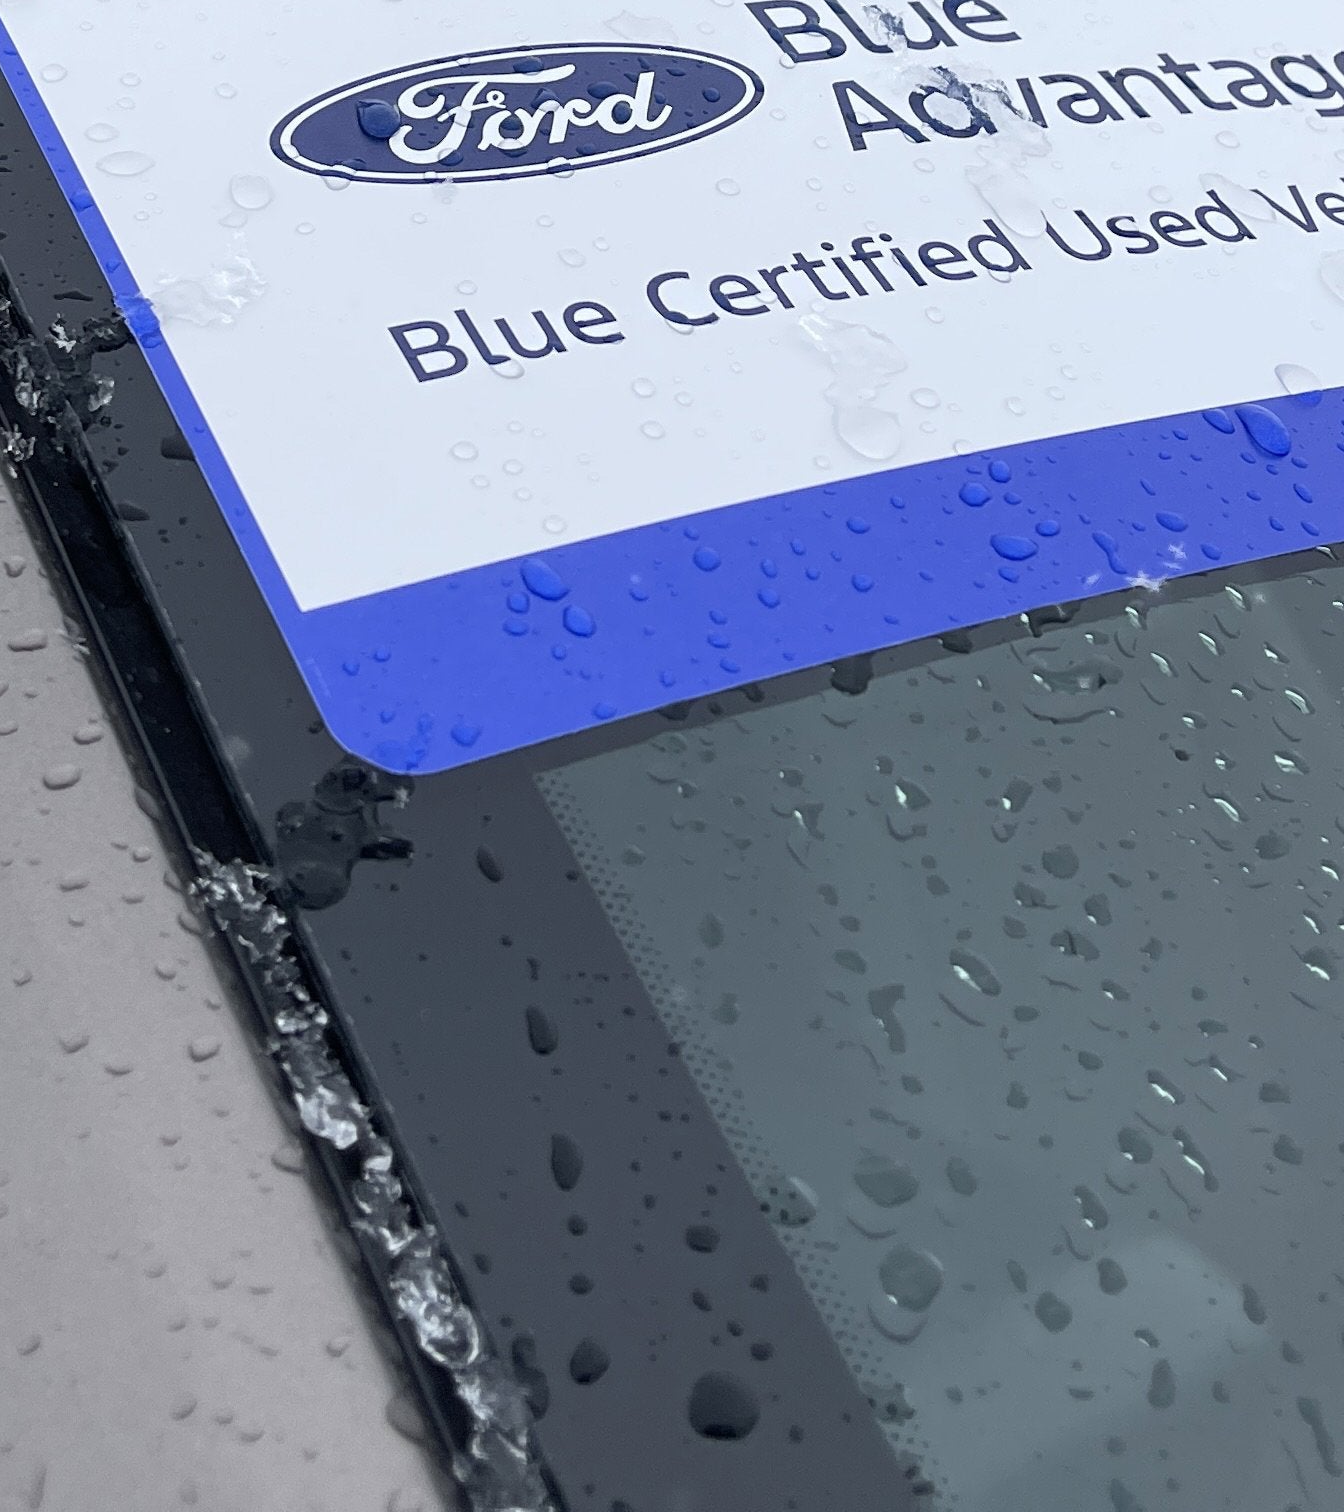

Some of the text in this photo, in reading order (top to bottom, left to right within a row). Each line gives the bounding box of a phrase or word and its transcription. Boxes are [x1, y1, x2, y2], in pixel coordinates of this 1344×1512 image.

[389, 65, 672, 163] Ford
[388, 302, 625, 383] Blue
[647, 219, 1032, 326] Certified
[1046, 190, 1257, 261] Used
